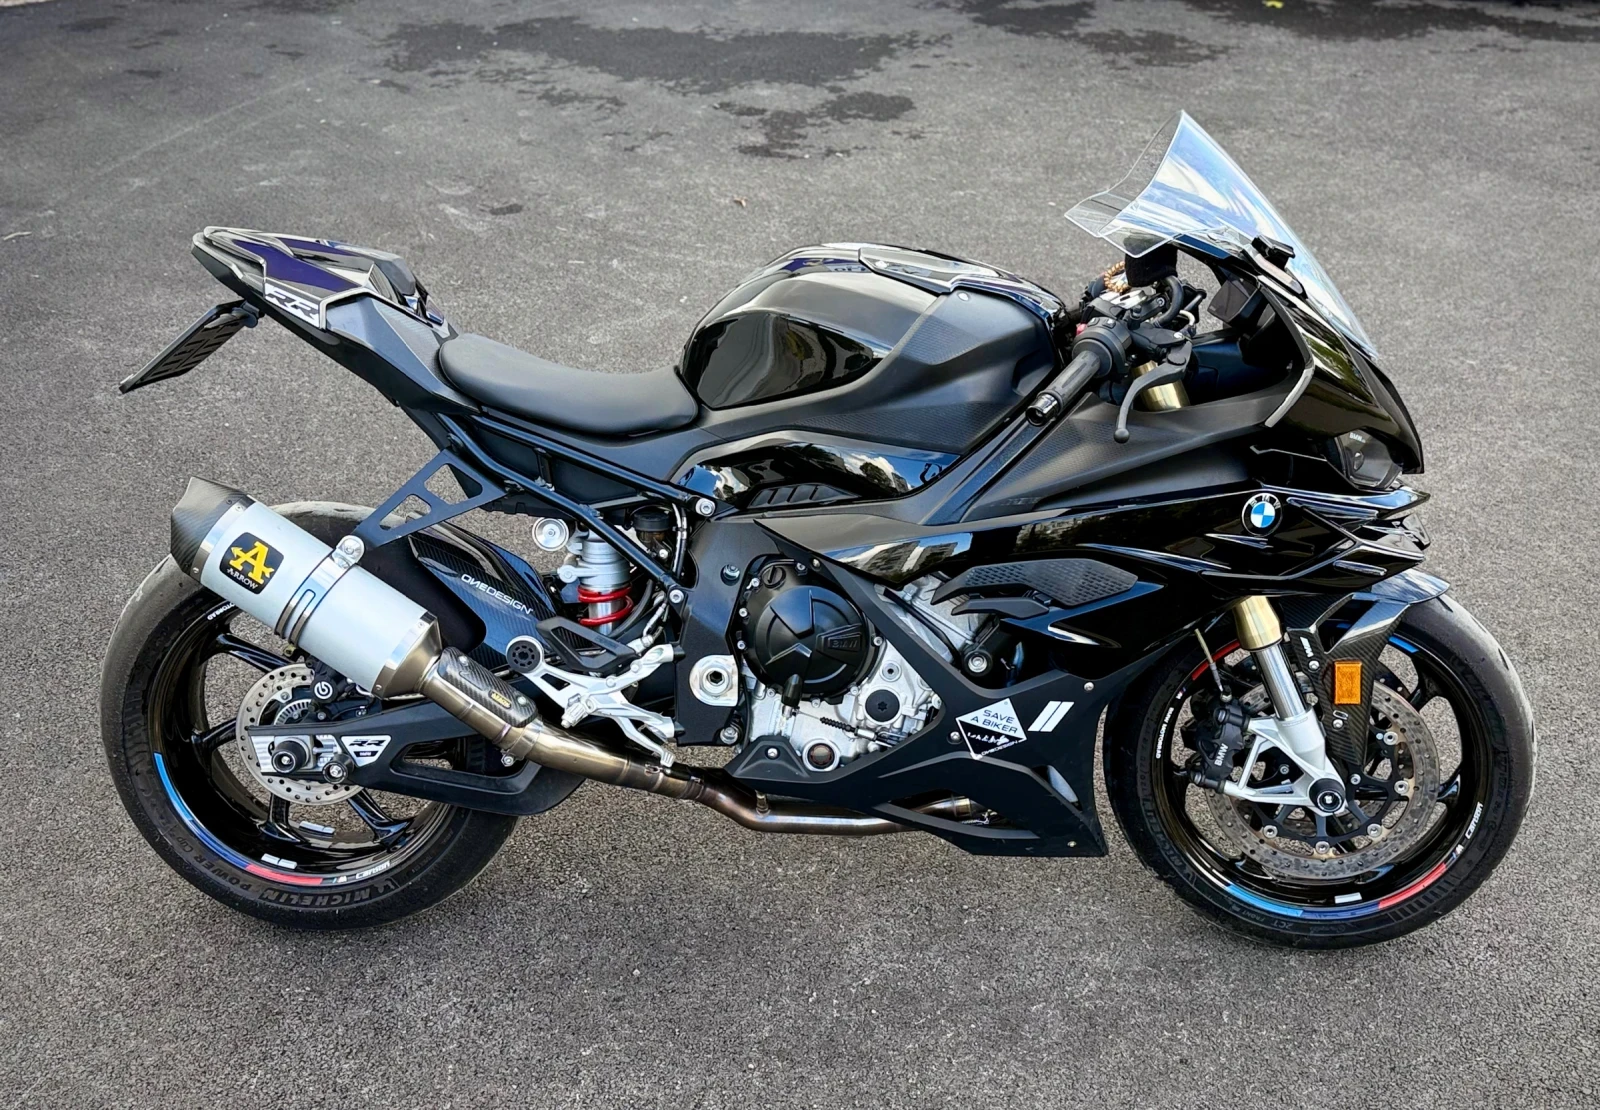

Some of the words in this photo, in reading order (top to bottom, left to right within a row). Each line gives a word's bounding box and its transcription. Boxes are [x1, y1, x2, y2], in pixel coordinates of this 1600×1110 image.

[264, 290, 319, 320] RR
[226, 568, 259, 589] ARROW
[461, 574, 533, 615] ONEDESIGN
[982, 719, 1018, 734] BIKER
[983, 709, 1015, 724] SAVE
[1214, 743, 1229, 767] BMW
[176, 835, 194, 853] Cup
[193, 854, 252, 891] POWER
[261, 887, 371, 906] MICHELIN
[1241, 910, 1266, 922] FRONT
